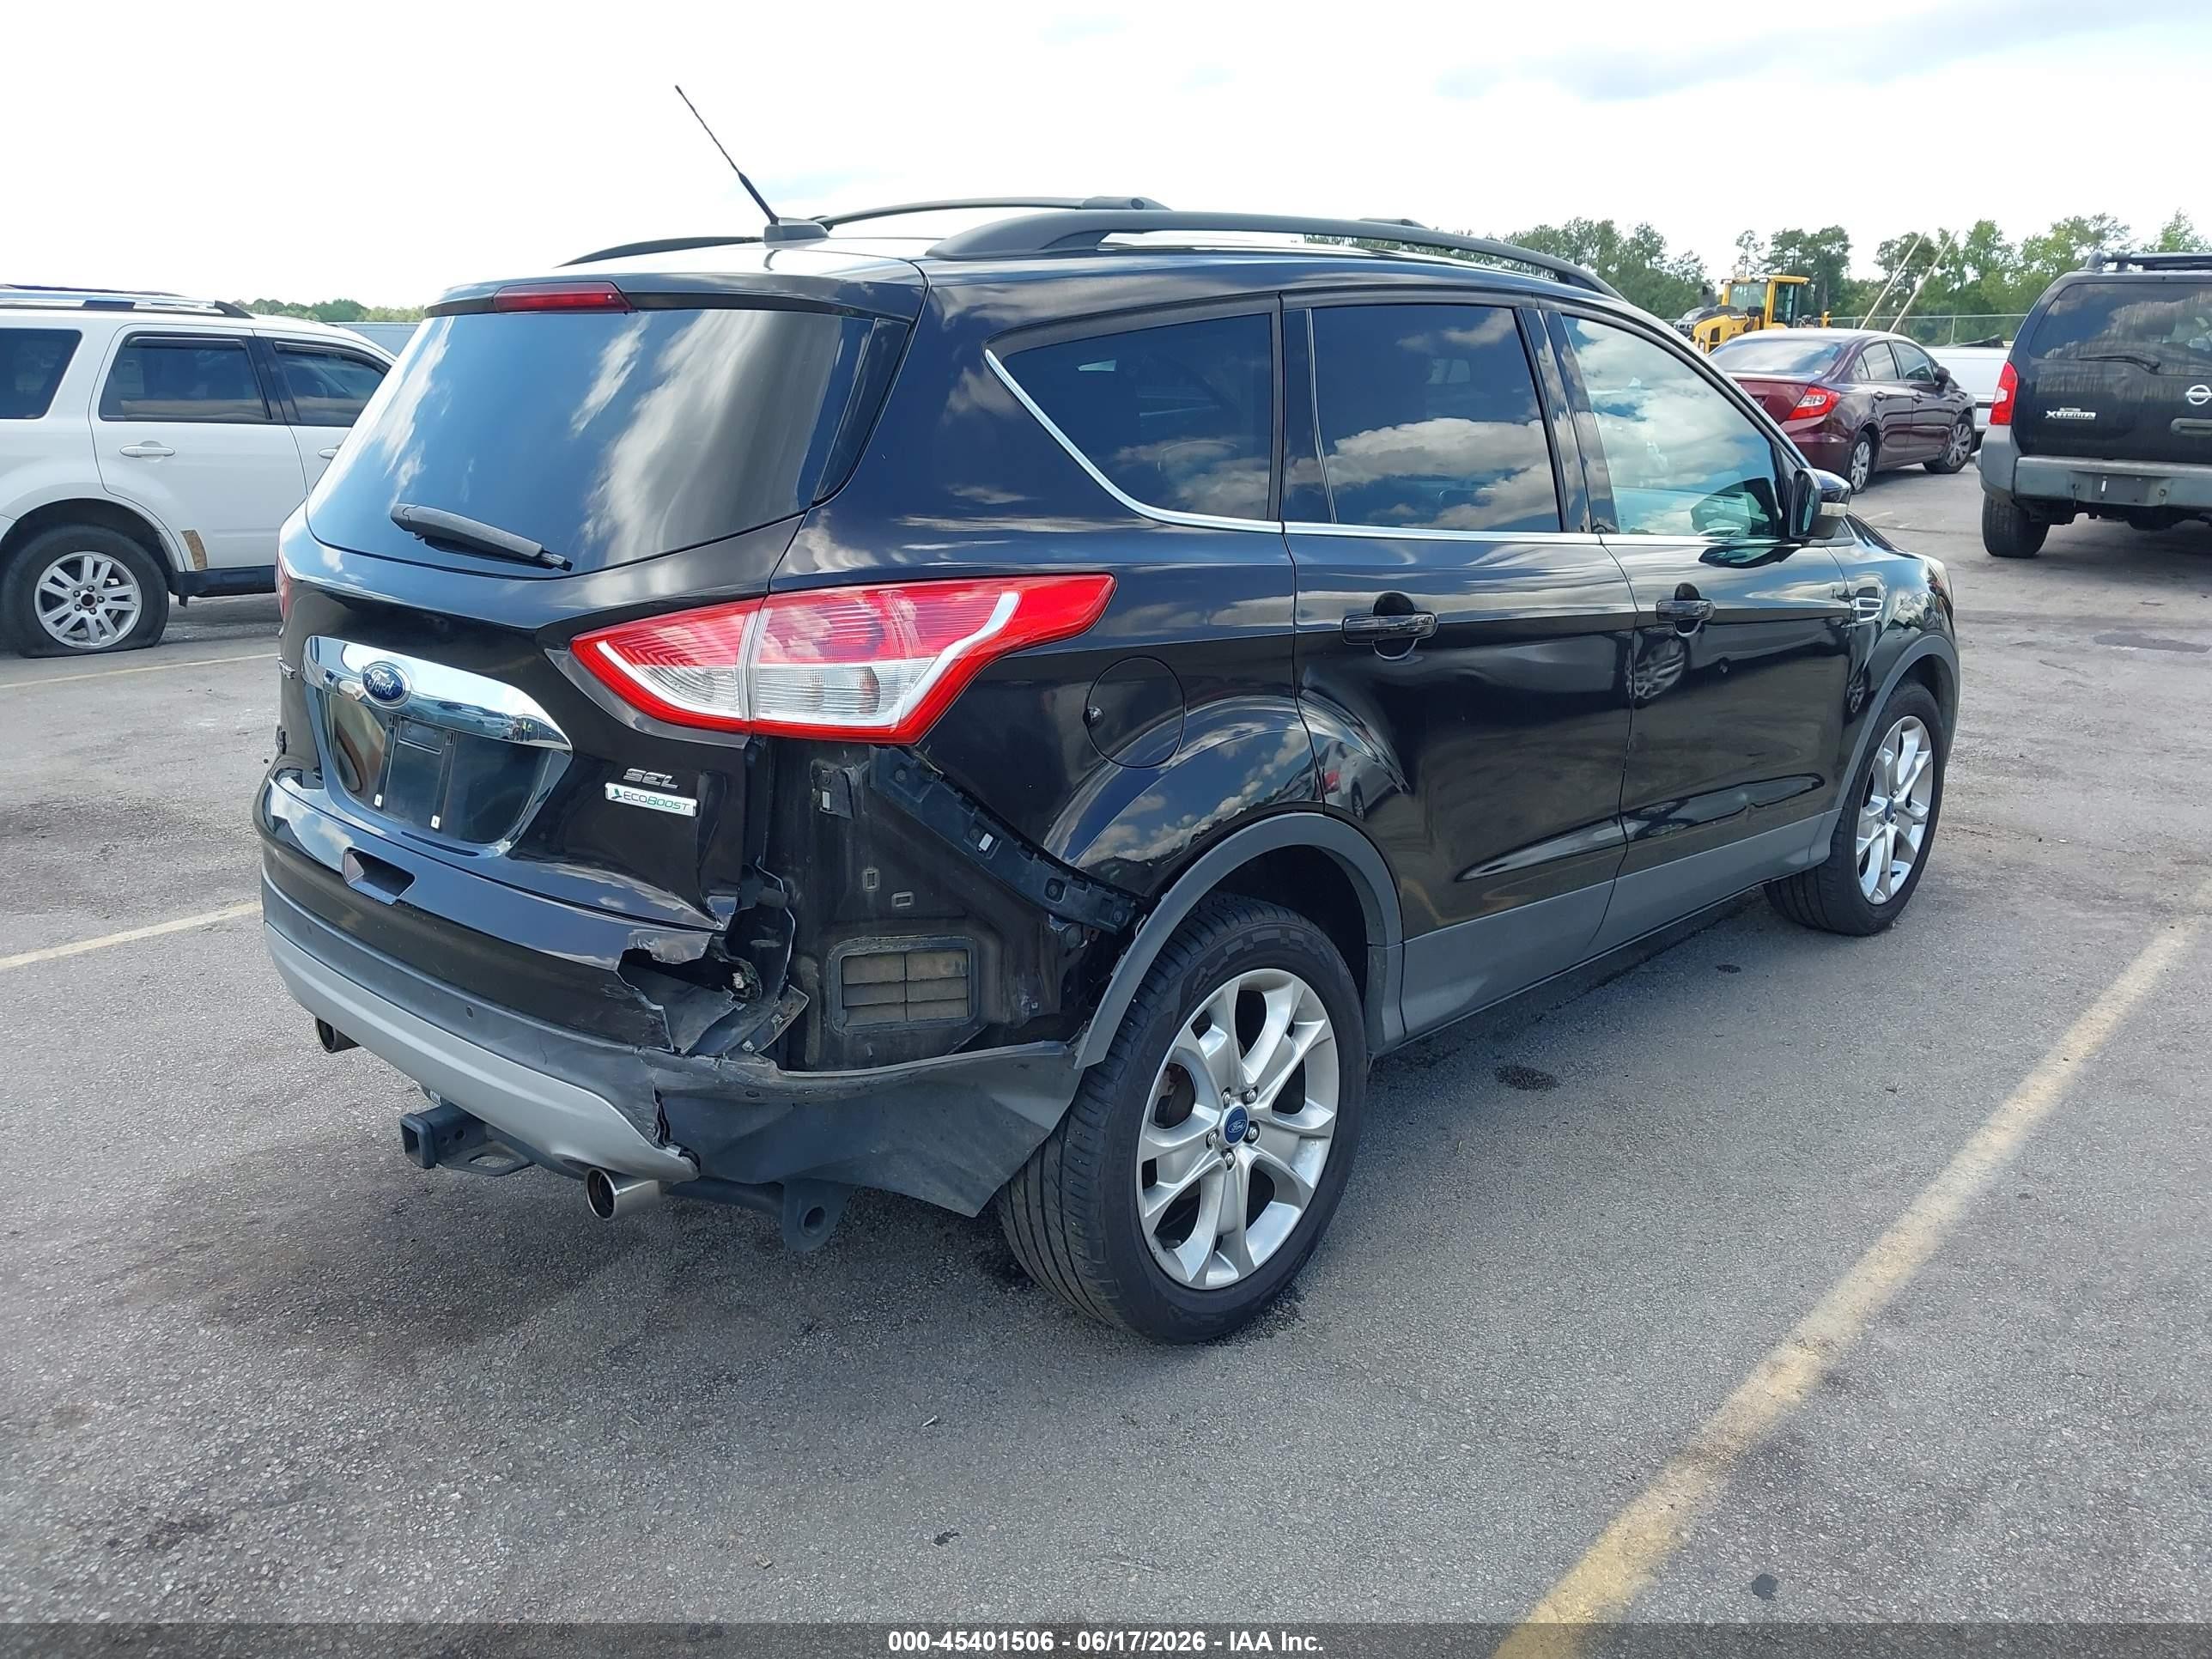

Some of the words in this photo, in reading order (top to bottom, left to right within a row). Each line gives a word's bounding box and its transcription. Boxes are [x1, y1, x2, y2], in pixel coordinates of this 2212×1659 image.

[368, 669, 395, 696] Ford
[623, 768, 679, 789] SEL
[623, 791, 690, 811] ECOBOOST
